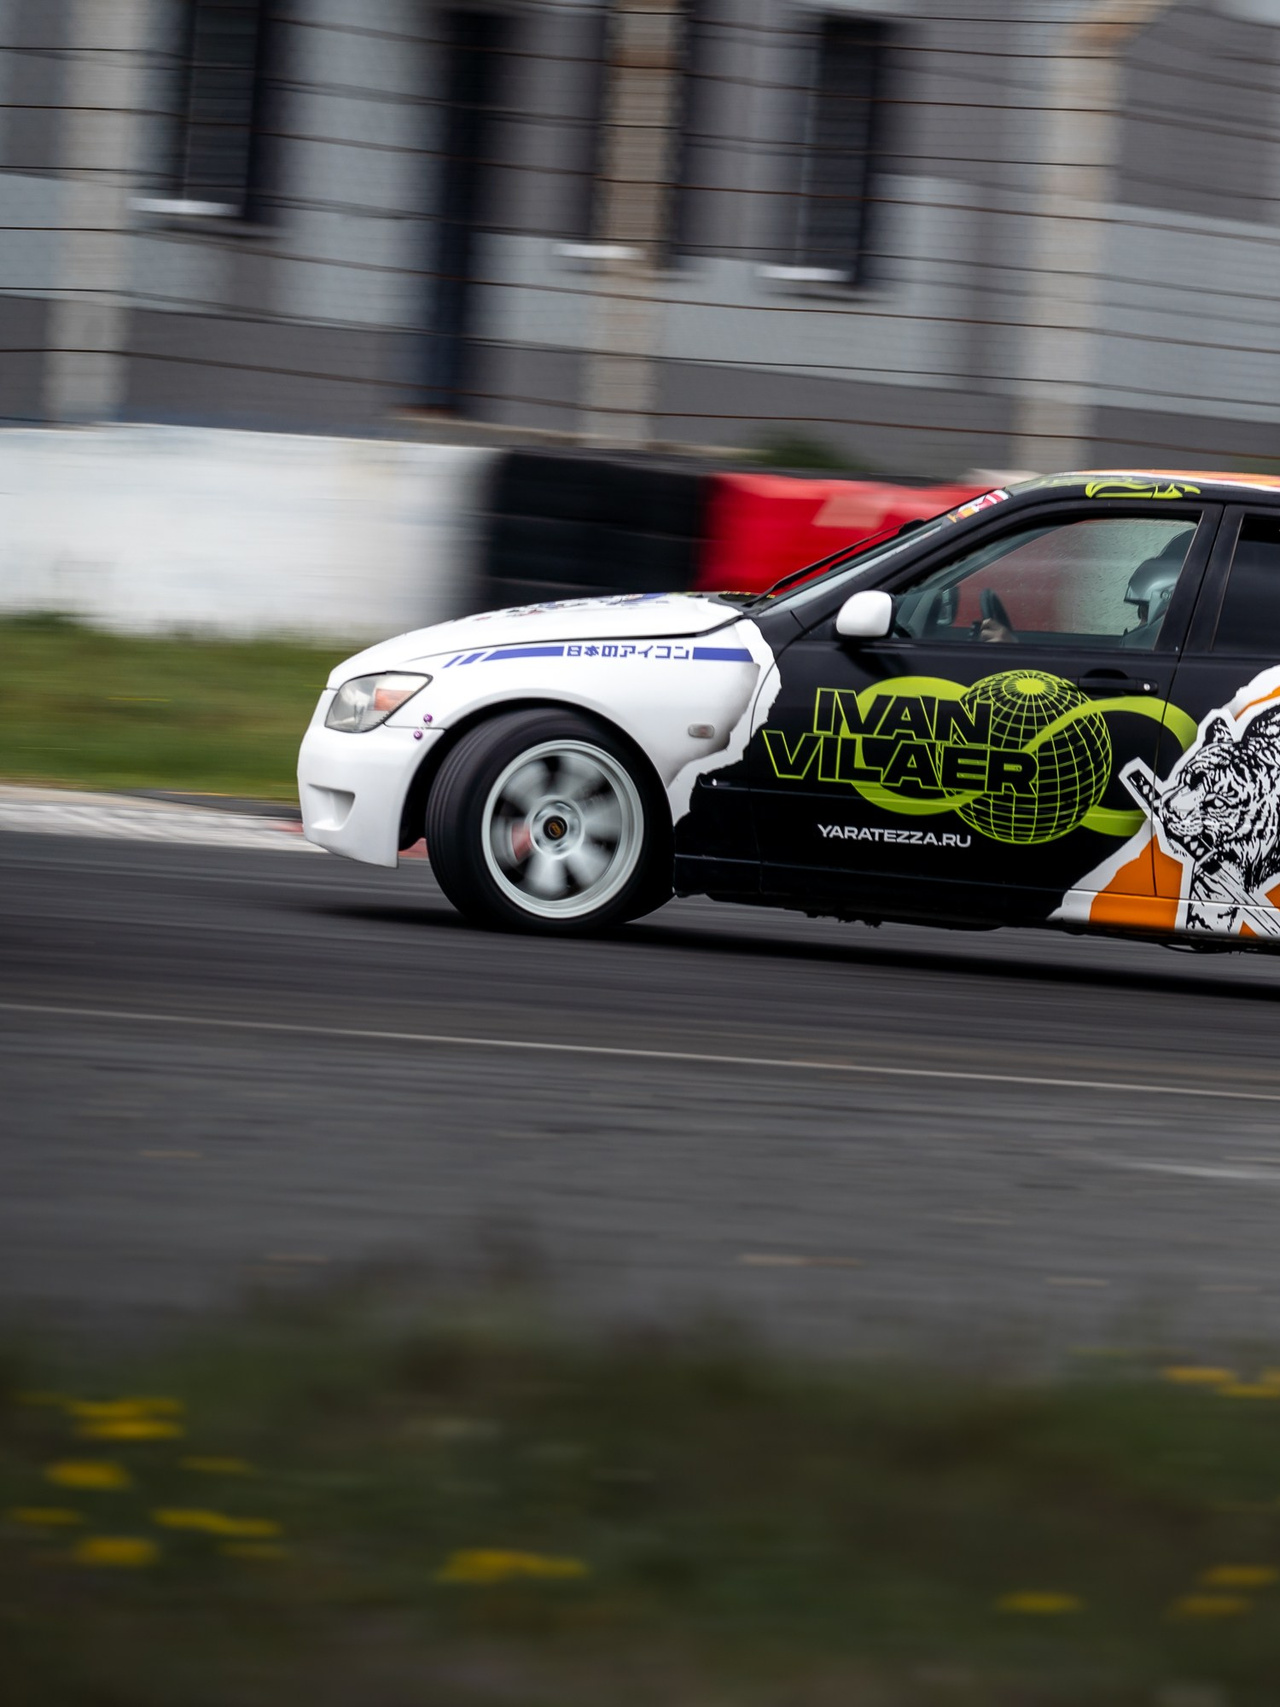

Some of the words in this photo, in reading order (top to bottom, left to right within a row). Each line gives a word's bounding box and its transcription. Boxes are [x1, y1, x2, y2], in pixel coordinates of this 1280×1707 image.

[566, 645, 690, 660] 日本のアイコン
[813, 687, 994, 749] IVAN
[762, 729, 1039, 799] VILAER
[817, 823, 972, 848] YARATEZZA.RU
